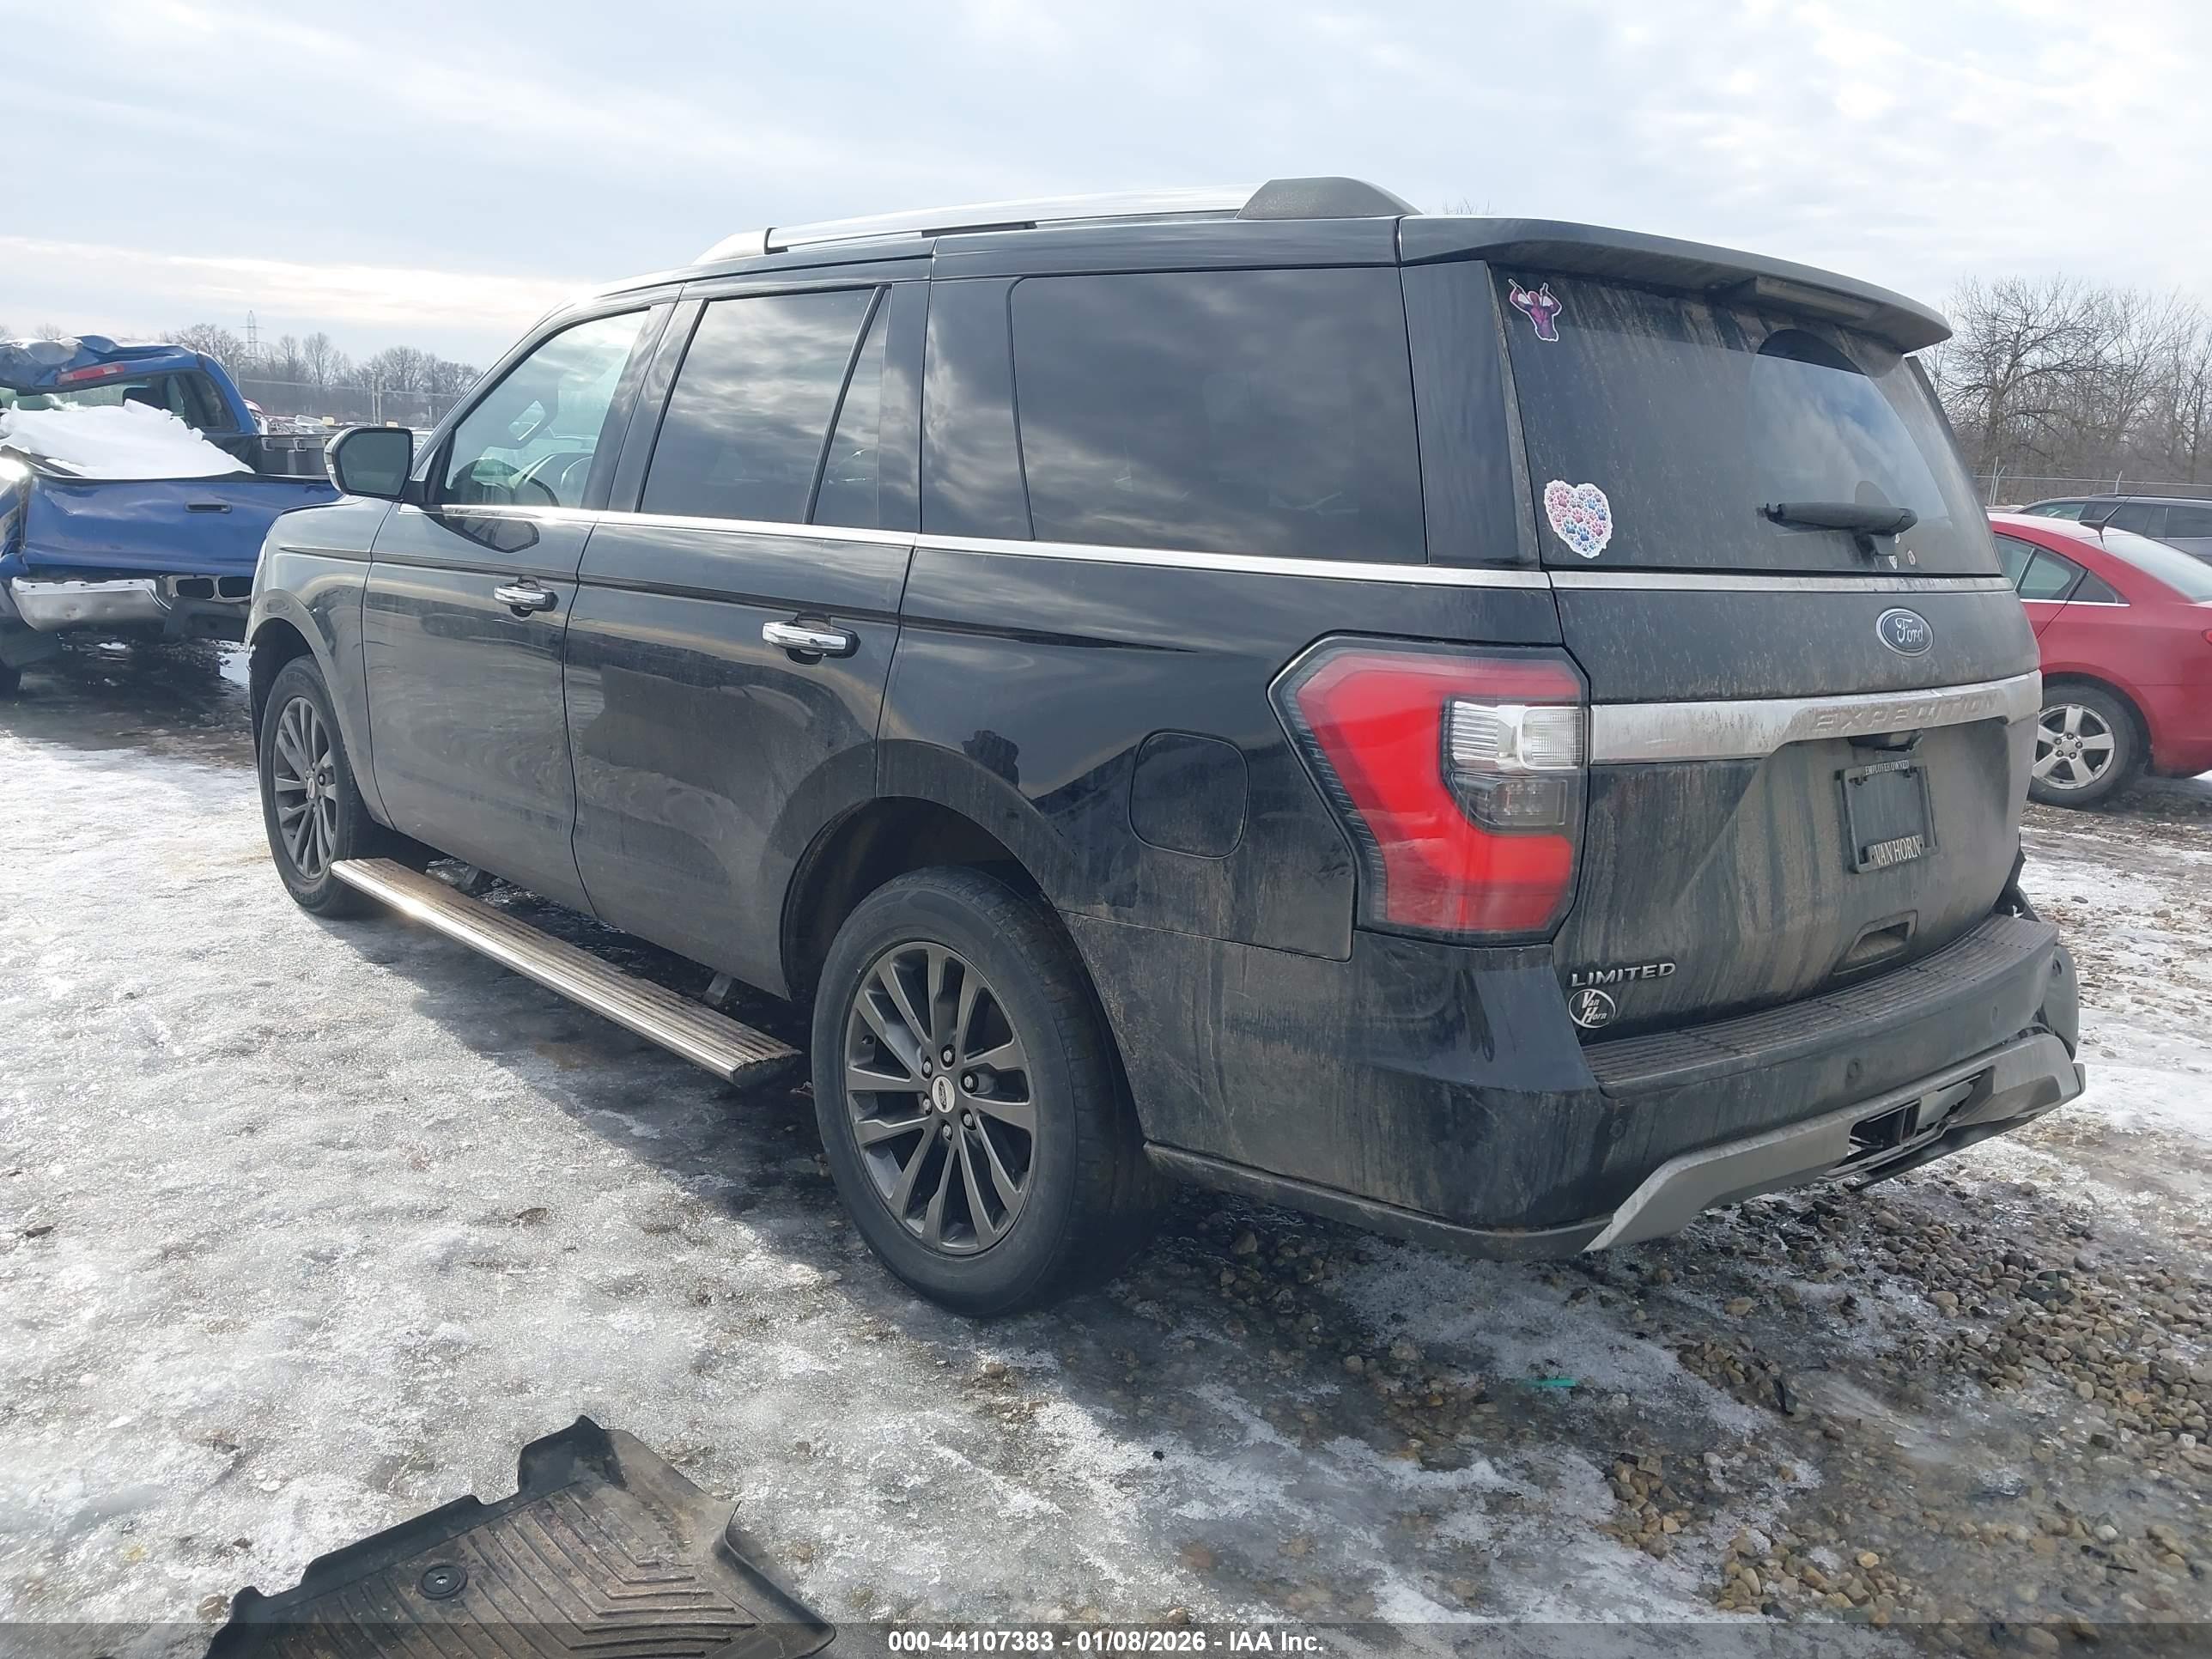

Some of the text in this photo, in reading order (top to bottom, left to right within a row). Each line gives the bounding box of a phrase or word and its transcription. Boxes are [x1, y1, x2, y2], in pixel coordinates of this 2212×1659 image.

[1894, 617, 1923, 643] Ford
[1874, 835, 1922, 866] VAN HORN
[1571, 963, 1676, 988] LIMITED
[1582, 1006, 1607, 1024] Horn
